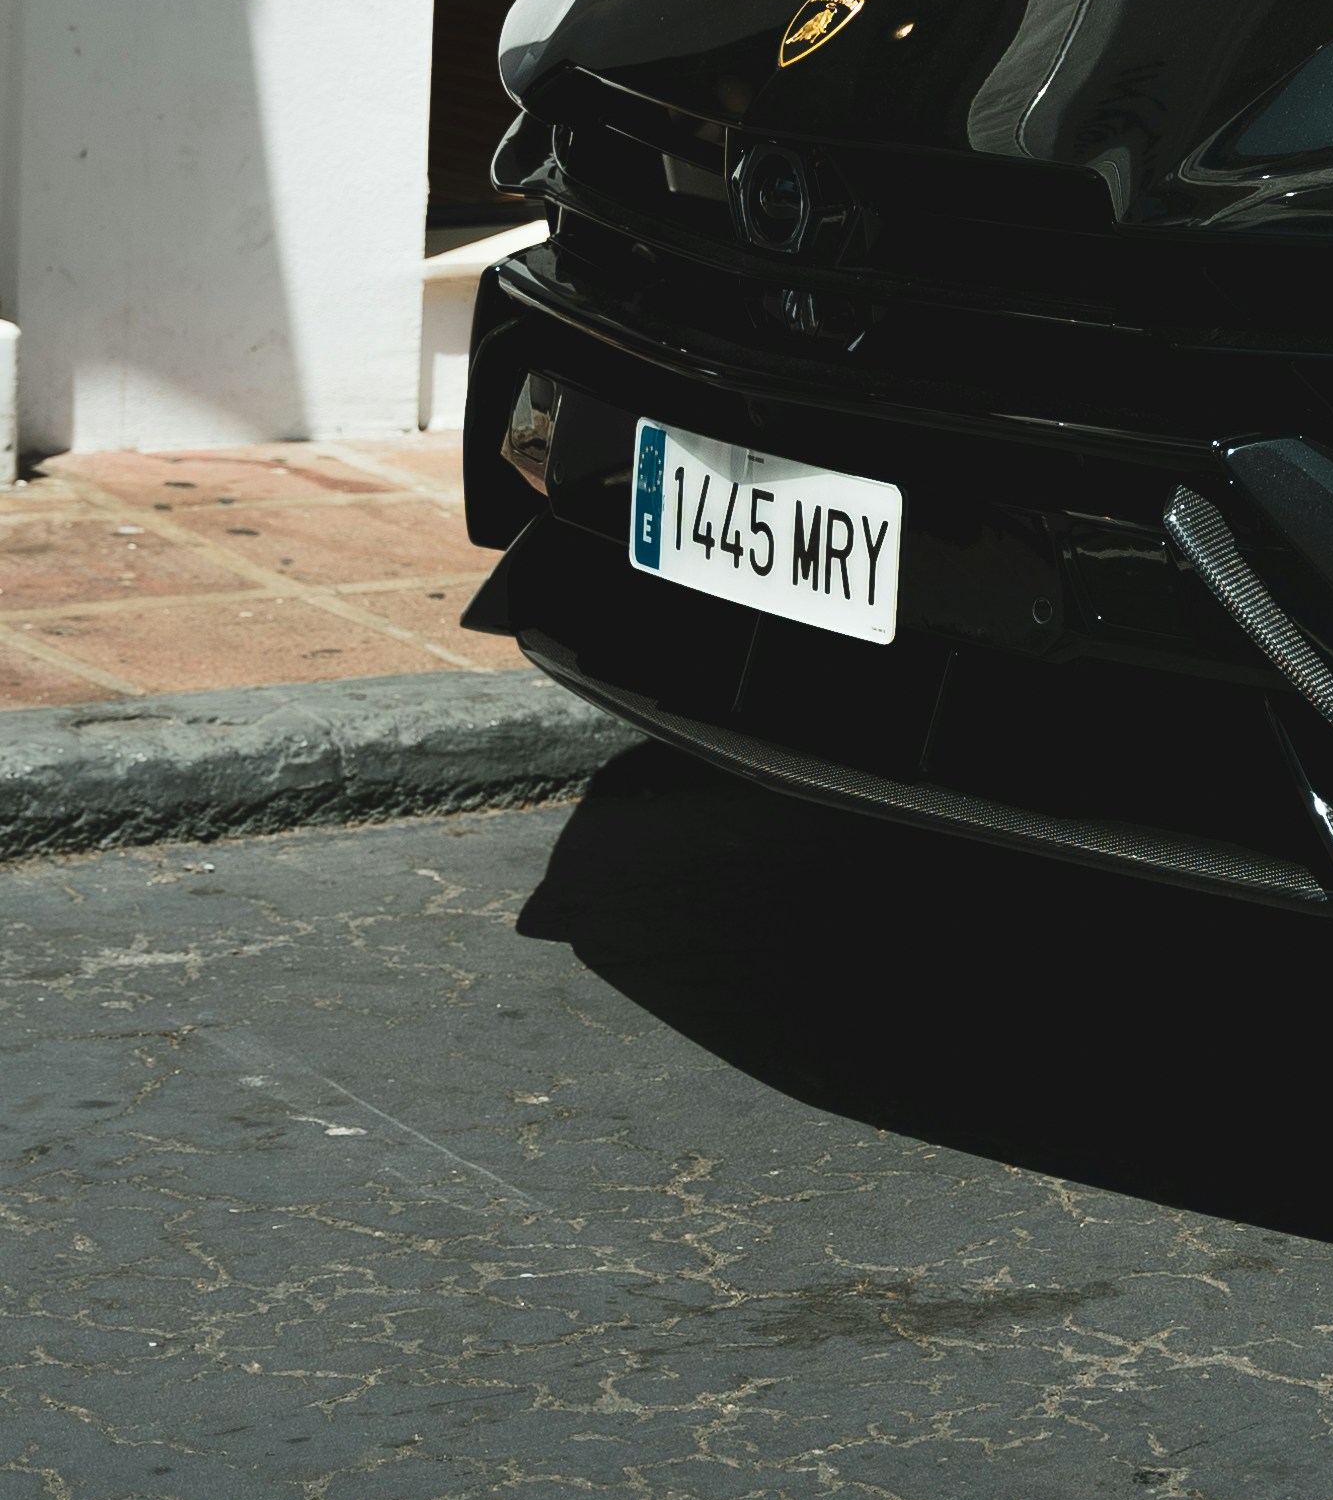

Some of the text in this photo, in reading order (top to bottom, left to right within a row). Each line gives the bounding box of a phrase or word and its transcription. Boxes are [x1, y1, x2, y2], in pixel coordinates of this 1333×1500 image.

[642, 512, 653, 543] E
[674, 466, 889, 606] 1445 MRY
